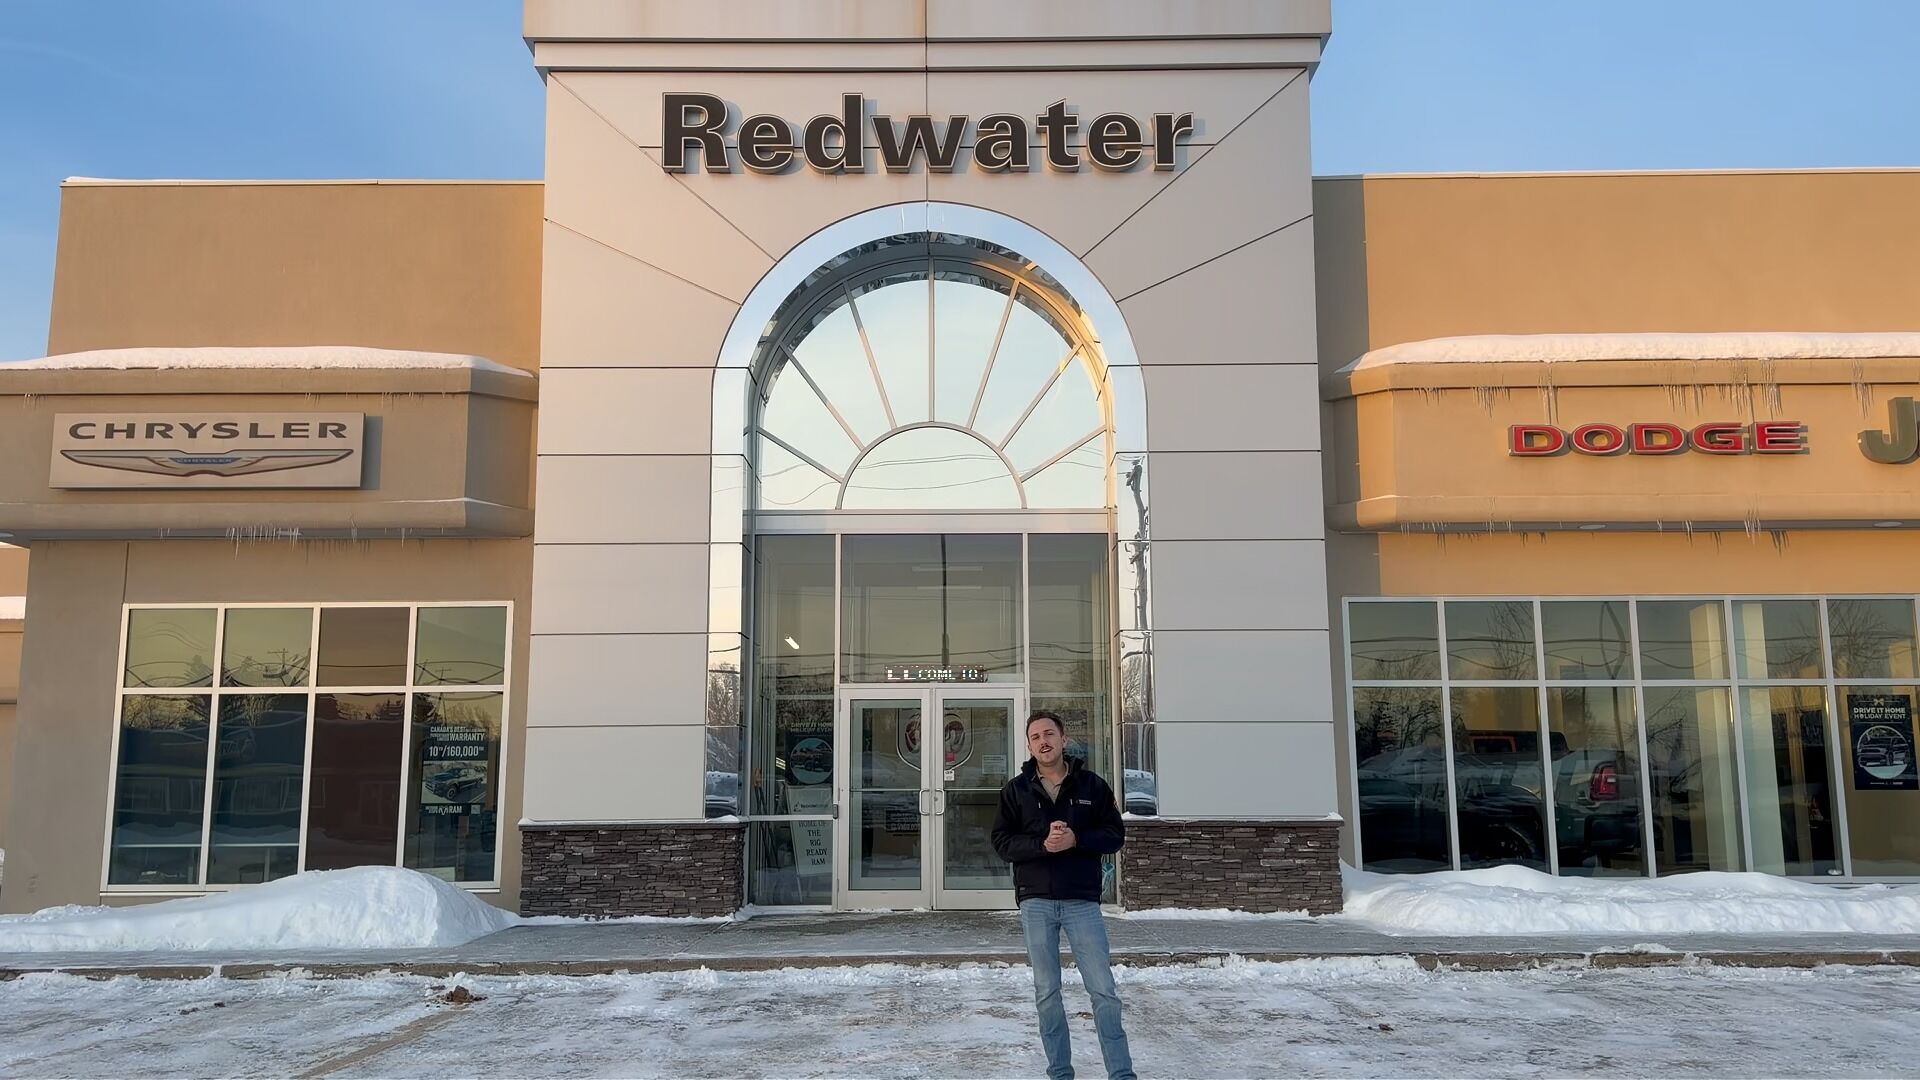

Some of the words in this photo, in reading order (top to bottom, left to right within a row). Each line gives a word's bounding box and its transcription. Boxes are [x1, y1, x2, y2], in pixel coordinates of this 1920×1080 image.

[662, 91, 1193, 173] Redwater
[69, 422, 347, 439] CHRYSLER
[1509, 421, 1804, 454] DODGE
[449, 733, 485, 741] WARRANTY
[449, 805, 463, 814] RAM
[807, 829, 821, 837] THE
[806, 848, 828, 857] READY
